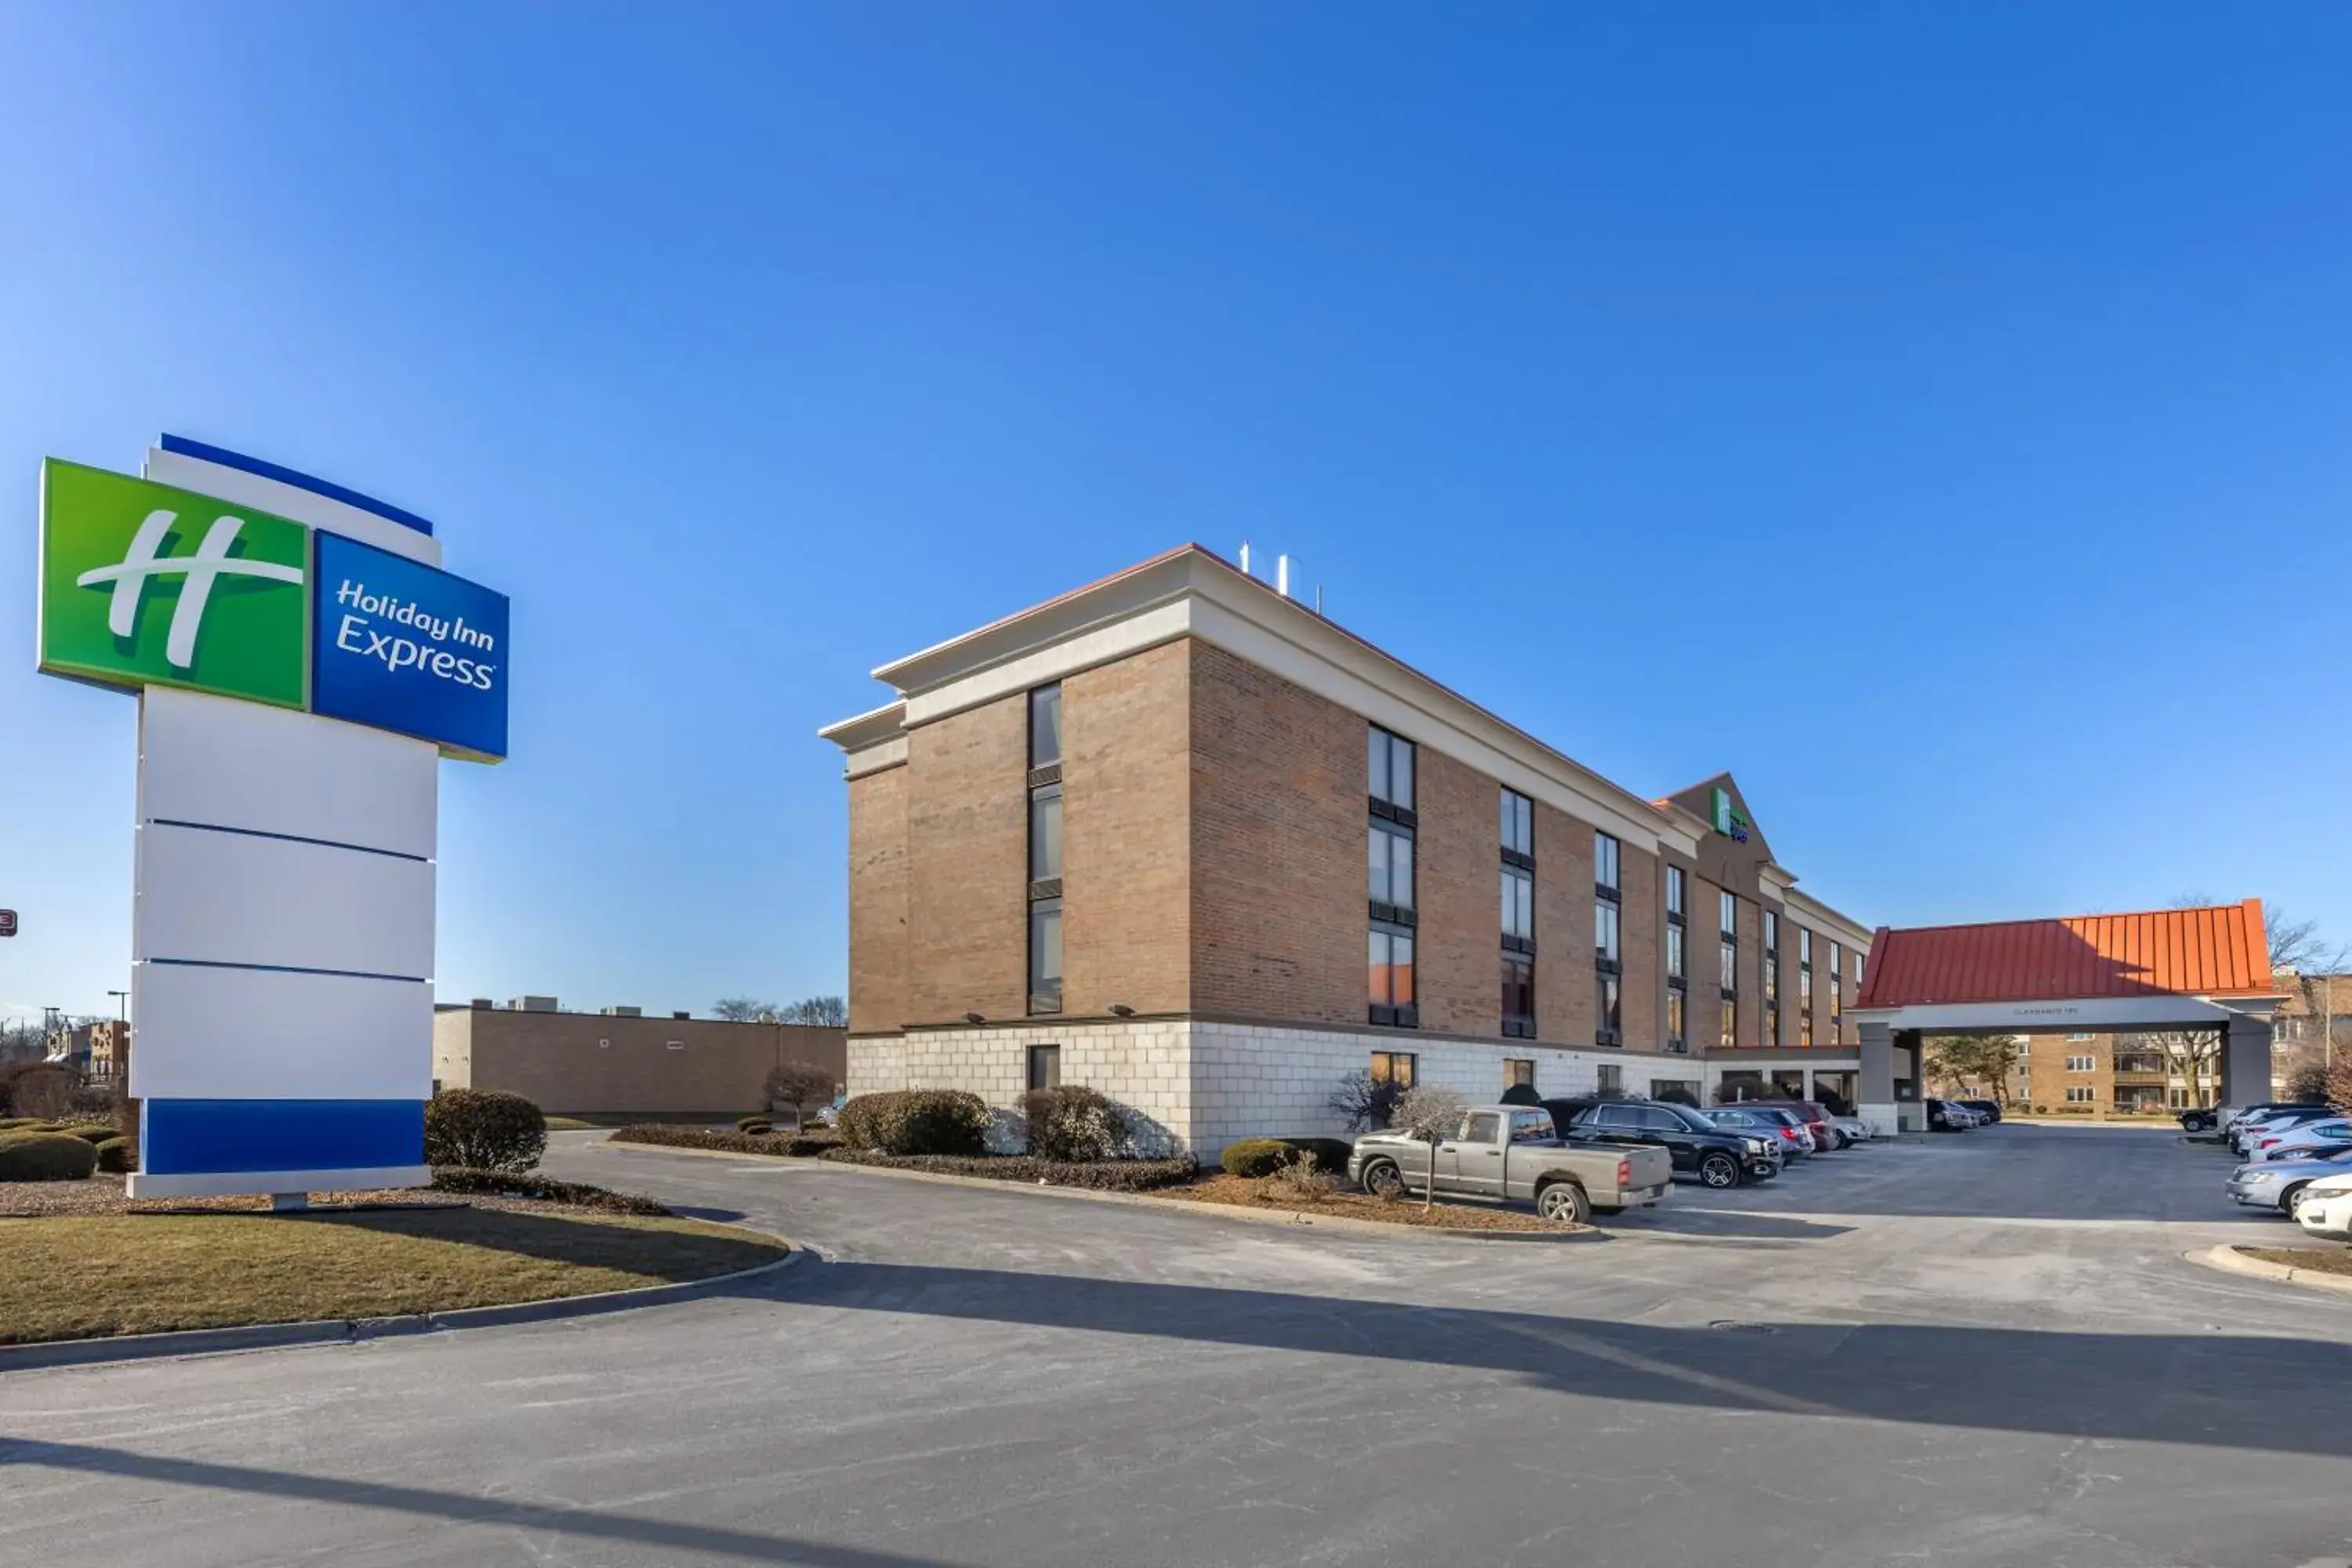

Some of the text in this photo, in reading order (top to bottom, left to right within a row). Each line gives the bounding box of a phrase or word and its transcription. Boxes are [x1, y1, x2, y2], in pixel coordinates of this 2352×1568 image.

[336, 579, 495, 652] Holiday Inn
[336, 614, 493, 690] Express
